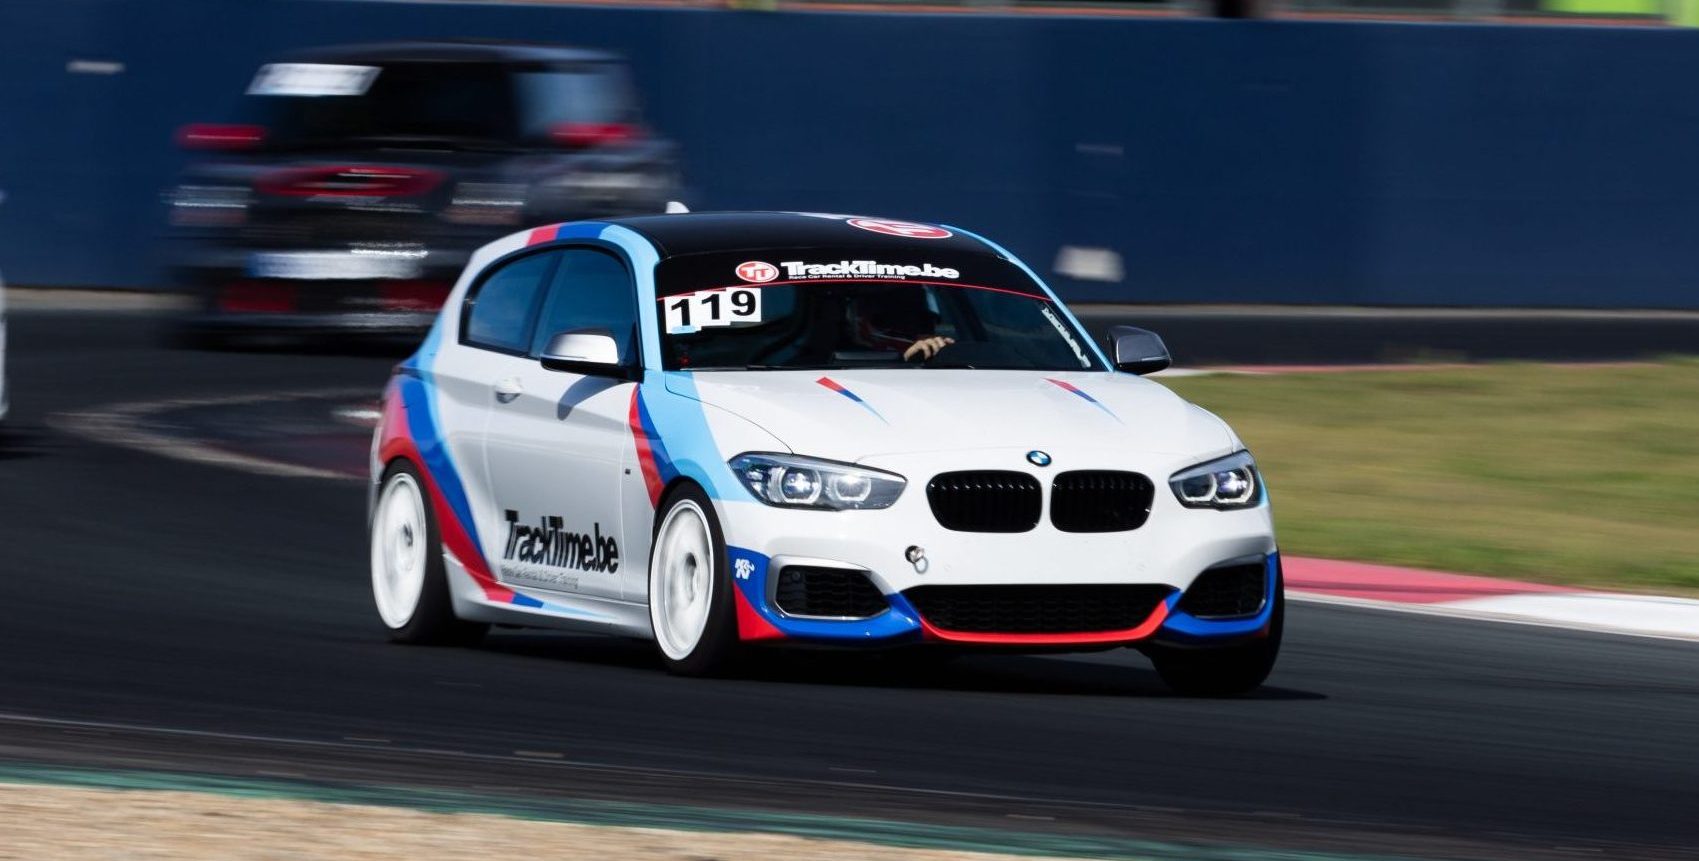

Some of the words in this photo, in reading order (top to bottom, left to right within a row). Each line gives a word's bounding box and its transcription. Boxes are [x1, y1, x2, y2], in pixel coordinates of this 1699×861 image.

[780, 260, 960, 279] TrackTime.be
[671, 290, 756, 326] 119
[503, 509, 619, 574] TrackTime.be
